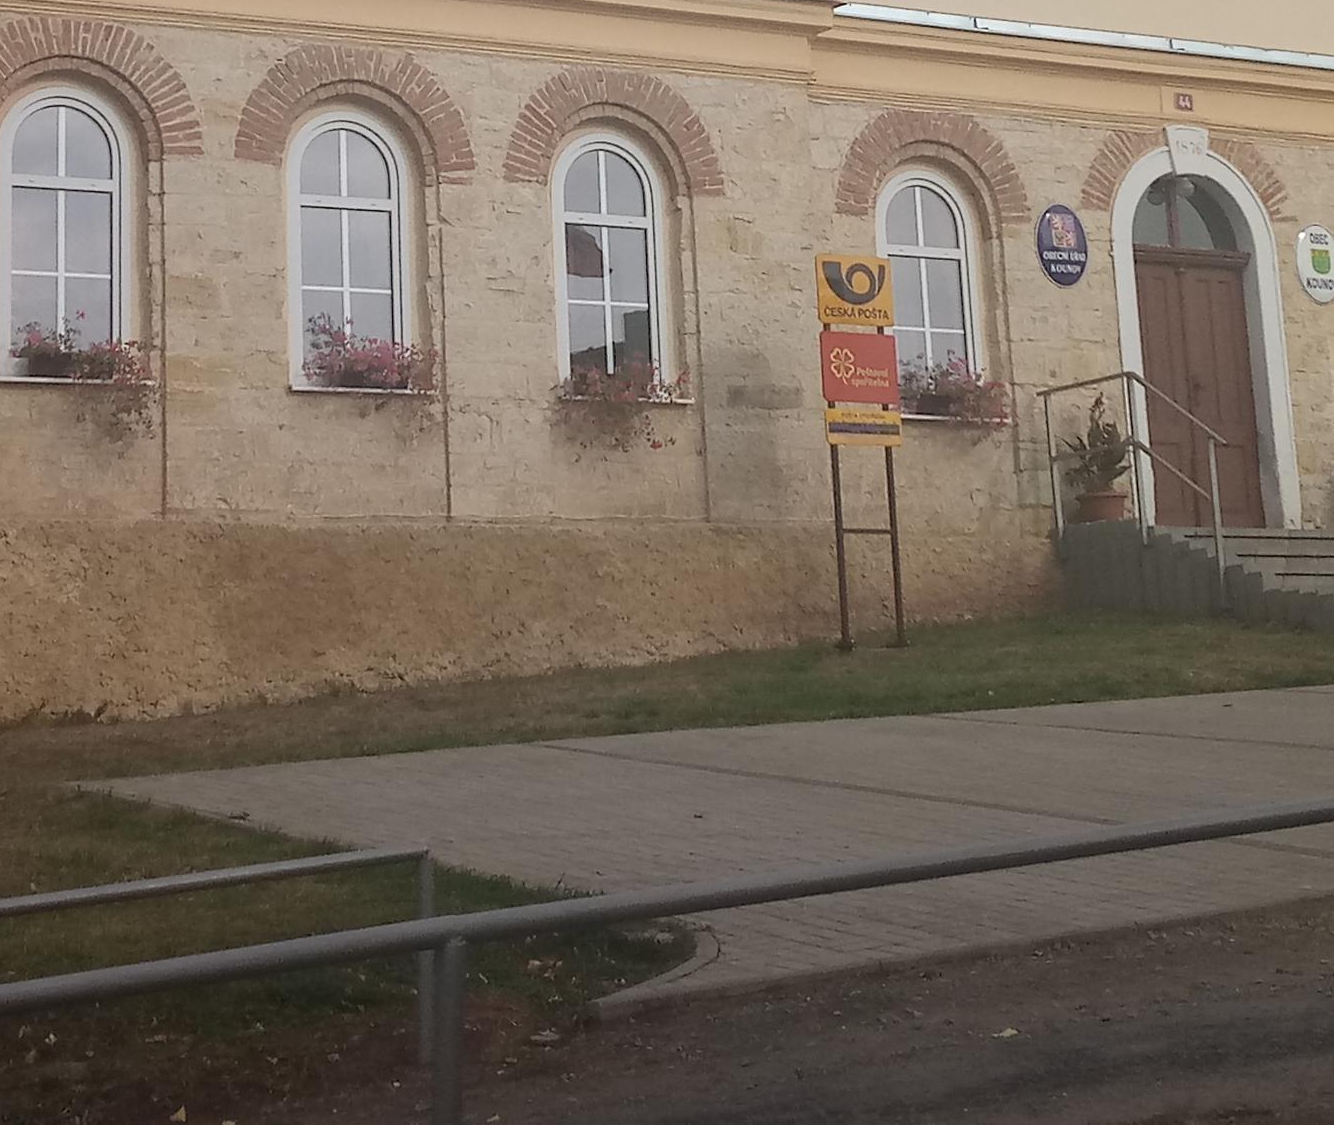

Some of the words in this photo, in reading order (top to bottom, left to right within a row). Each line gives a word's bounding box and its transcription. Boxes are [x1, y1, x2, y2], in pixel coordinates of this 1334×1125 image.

[1178, 95, 1191, 109] 44
[1309, 232, 1329, 246] OBEC
[1050, 263, 1082, 274] KOUNOV
[824, 305, 856, 318] ČESKÁ
[857, 307, 890, 320] POŠTA
